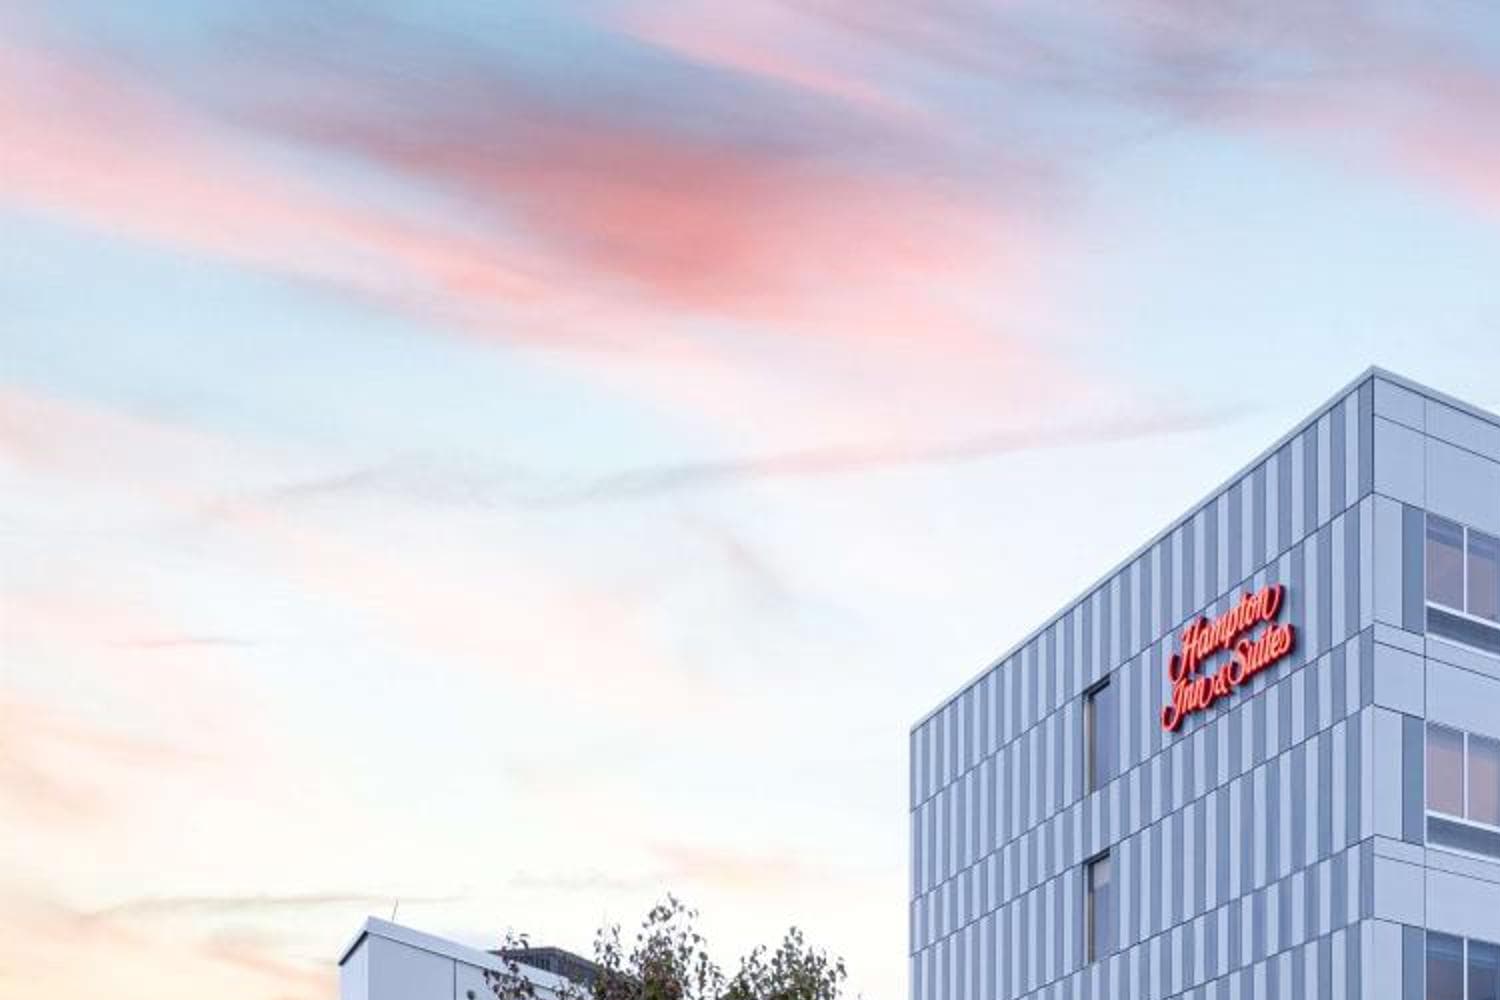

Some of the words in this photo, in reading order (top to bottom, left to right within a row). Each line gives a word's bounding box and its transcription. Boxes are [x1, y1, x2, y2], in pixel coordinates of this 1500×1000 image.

[1161, 678, 1214, 732] Inn
[1228, 624, 1295, 686] Suites
[1168, 583, 1285, 685] Hampton
